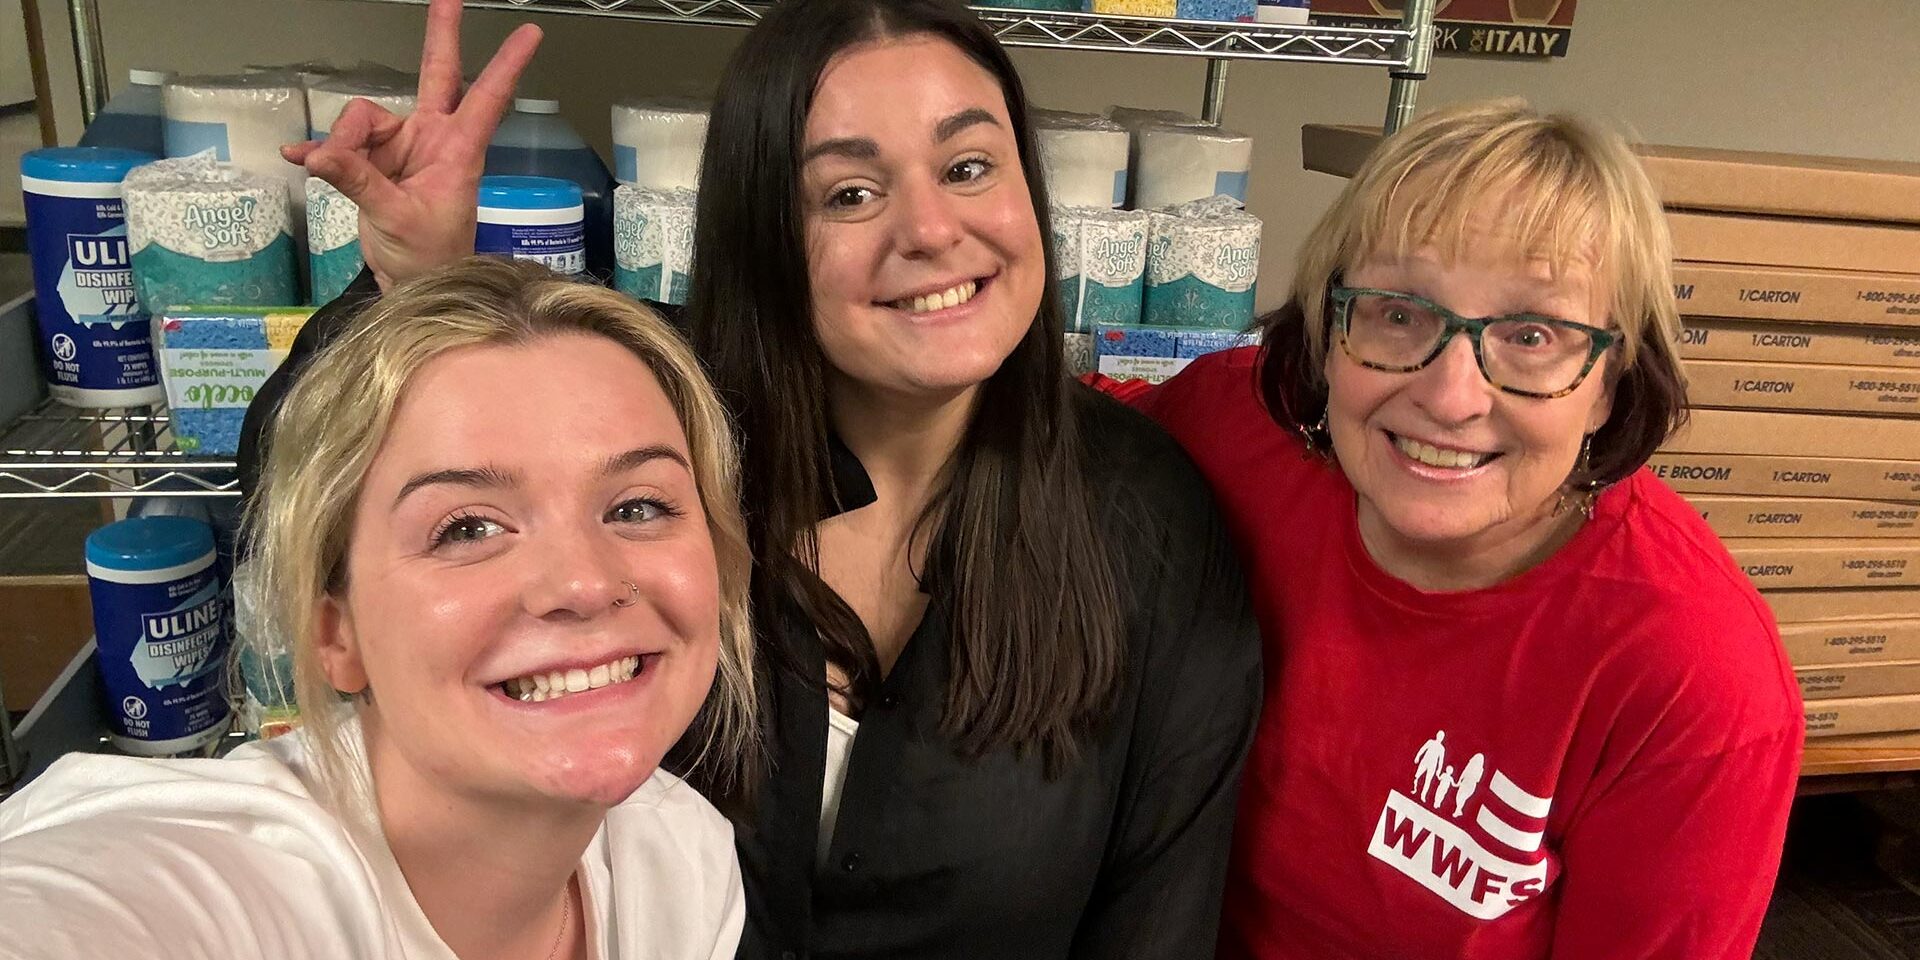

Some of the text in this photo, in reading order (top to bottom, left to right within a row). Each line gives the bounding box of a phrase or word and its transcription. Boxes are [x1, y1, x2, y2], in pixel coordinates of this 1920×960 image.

[1432, 25, 1460, 50] RK
[1485, 29, 1560, 54] ITALY
[184, 200, 256, 229] Angel
[310, 198, 328, 221] gel
[203, 222, 250, 249] Soft
[617, 219, 645, 240] ngel
[75, 240, 127, 266] ULI
[1098, 234, 1140, 260] Angel
[1107, 254, 1135, 276] Soft
[76, 272, 133, 288] DISINFE
[103, 289, 138, 305] WIP
[1739, 289, 1800, 304] 1/CARTON
[1857, 290, 1920, 304] 1-800-295-55
[1886, 306, 1920, 315] uline.co
[1752, 333, 1811, 348] 1/CARTON
[53, 361, 80, 373] DO NOT
[170, 368, 266, 378] MULTI-PURPOSE
[57, 371, 79, 383] FLUSH
[1733, 379, 1794, 393] 1/CARTON
[184, 383, 254, 410] ocelo
[1670, 465, 1732, 480] BROOM
[1772, 470, 1831, 484] 1/CARTON
[1747, 513, 1802, 524] 1/CARTON
[149, 599, 218, 639] ULINE
[173, 646, 211, 669] WIPES
[123, 718, 150, 729] DO NOT
[1384, 805, 1544, 906] WWFS
